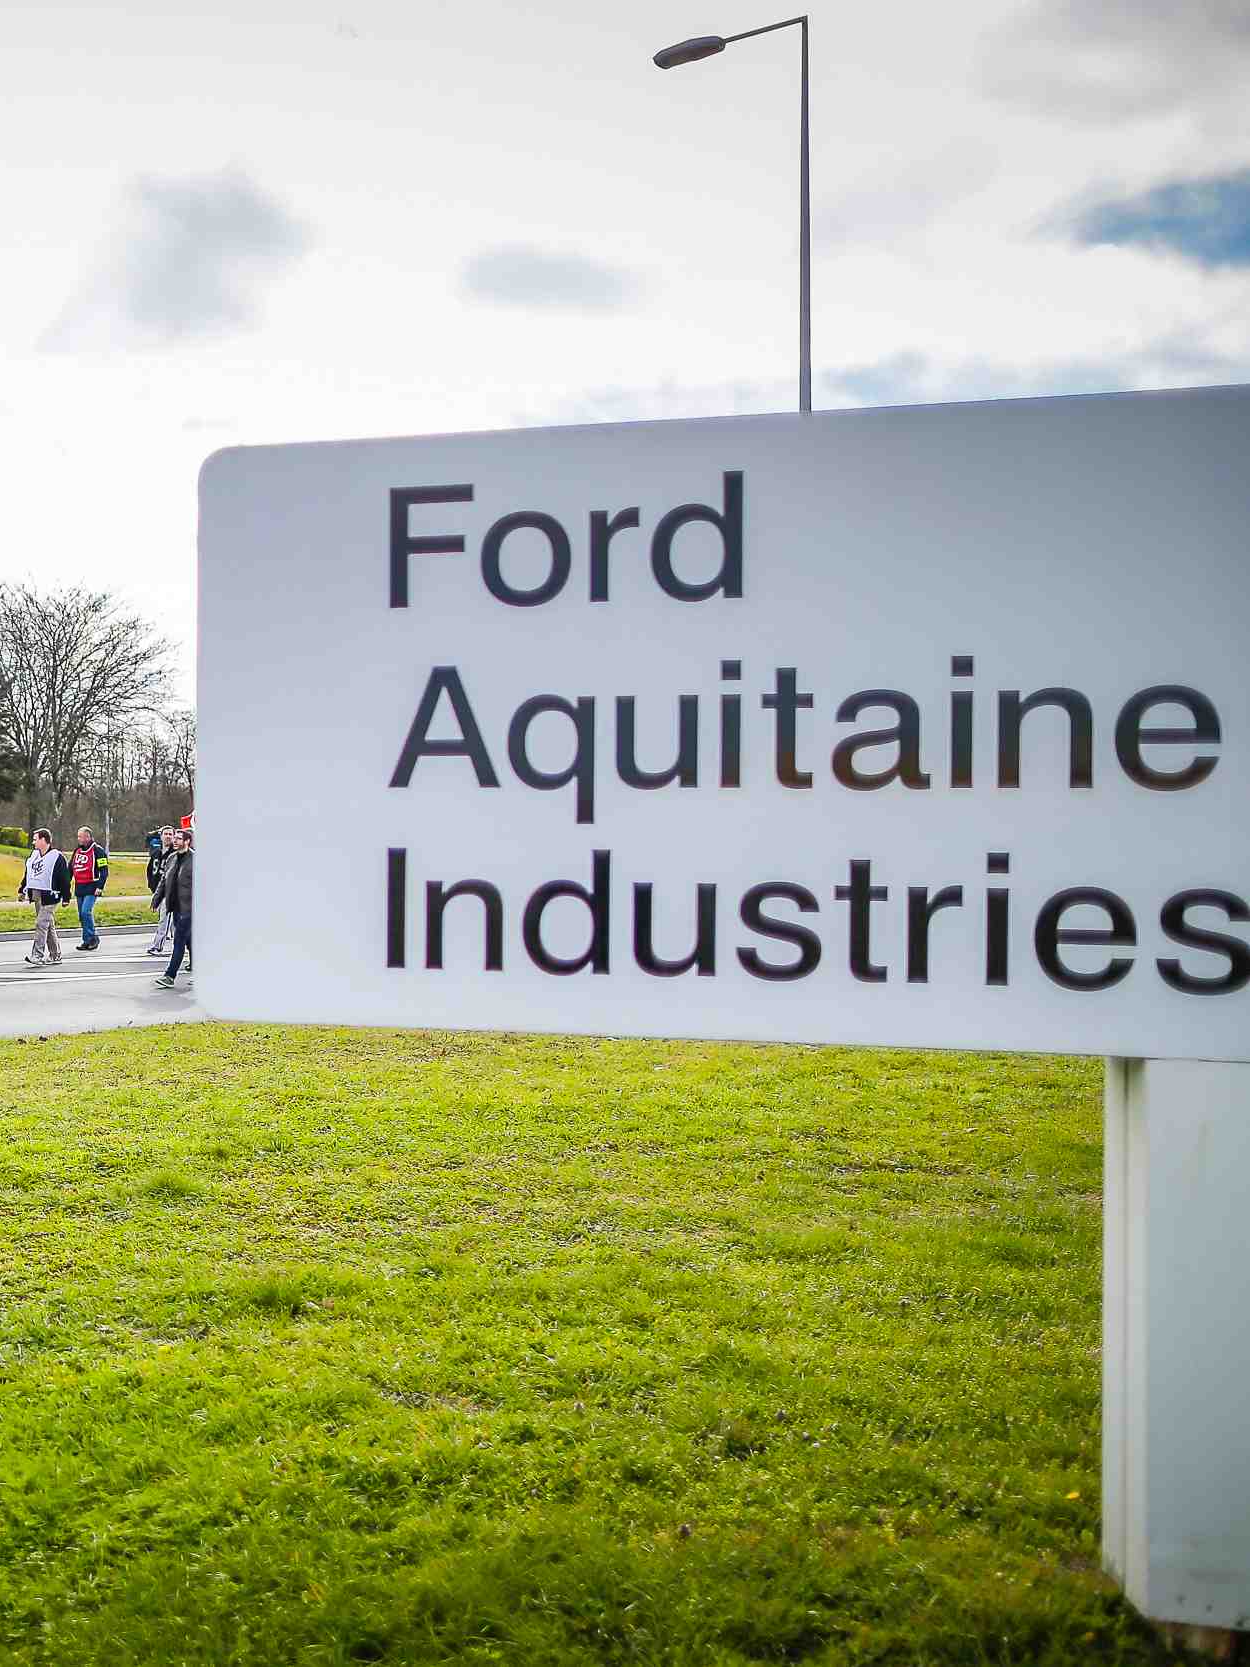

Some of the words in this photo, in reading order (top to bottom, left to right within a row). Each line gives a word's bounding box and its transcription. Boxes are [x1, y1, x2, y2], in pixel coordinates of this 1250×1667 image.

[388, 469, 744, 609] Ford
[388, 654, 1223, 825] Aquitaine
[385, 846, 1250, 996] Industries
